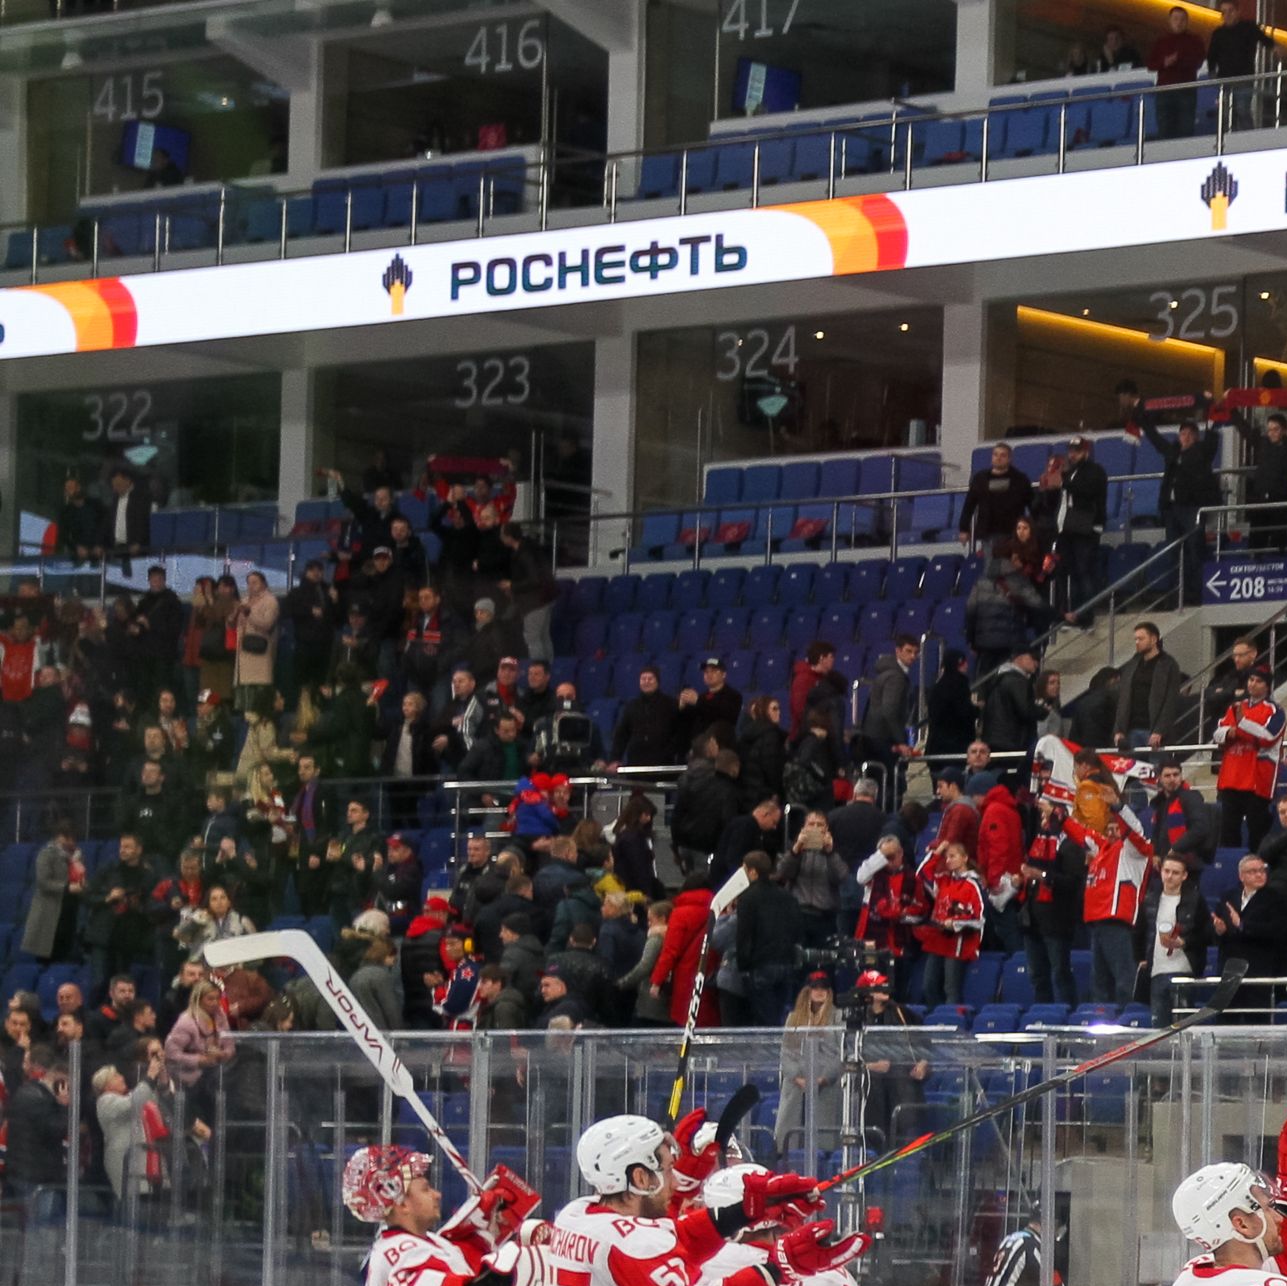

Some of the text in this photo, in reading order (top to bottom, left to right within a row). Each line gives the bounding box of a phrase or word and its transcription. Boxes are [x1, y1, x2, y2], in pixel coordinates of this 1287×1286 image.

[722, 0, 797, 39] 417
[464, 21, 543, 73] 416
[92, 74, 164, 121] 415
[450, 233, 748, 301] РОСНЕФТЬ
[1150, 286, 1239, 341] 325
[716, 326, 799, 382] 324
[454, 357, 531, 408] 323
[83, 392, 153, 441] 322
[1229, 576, 1266, 600] 208
[326, 964, 384, 1067] VAPOR
